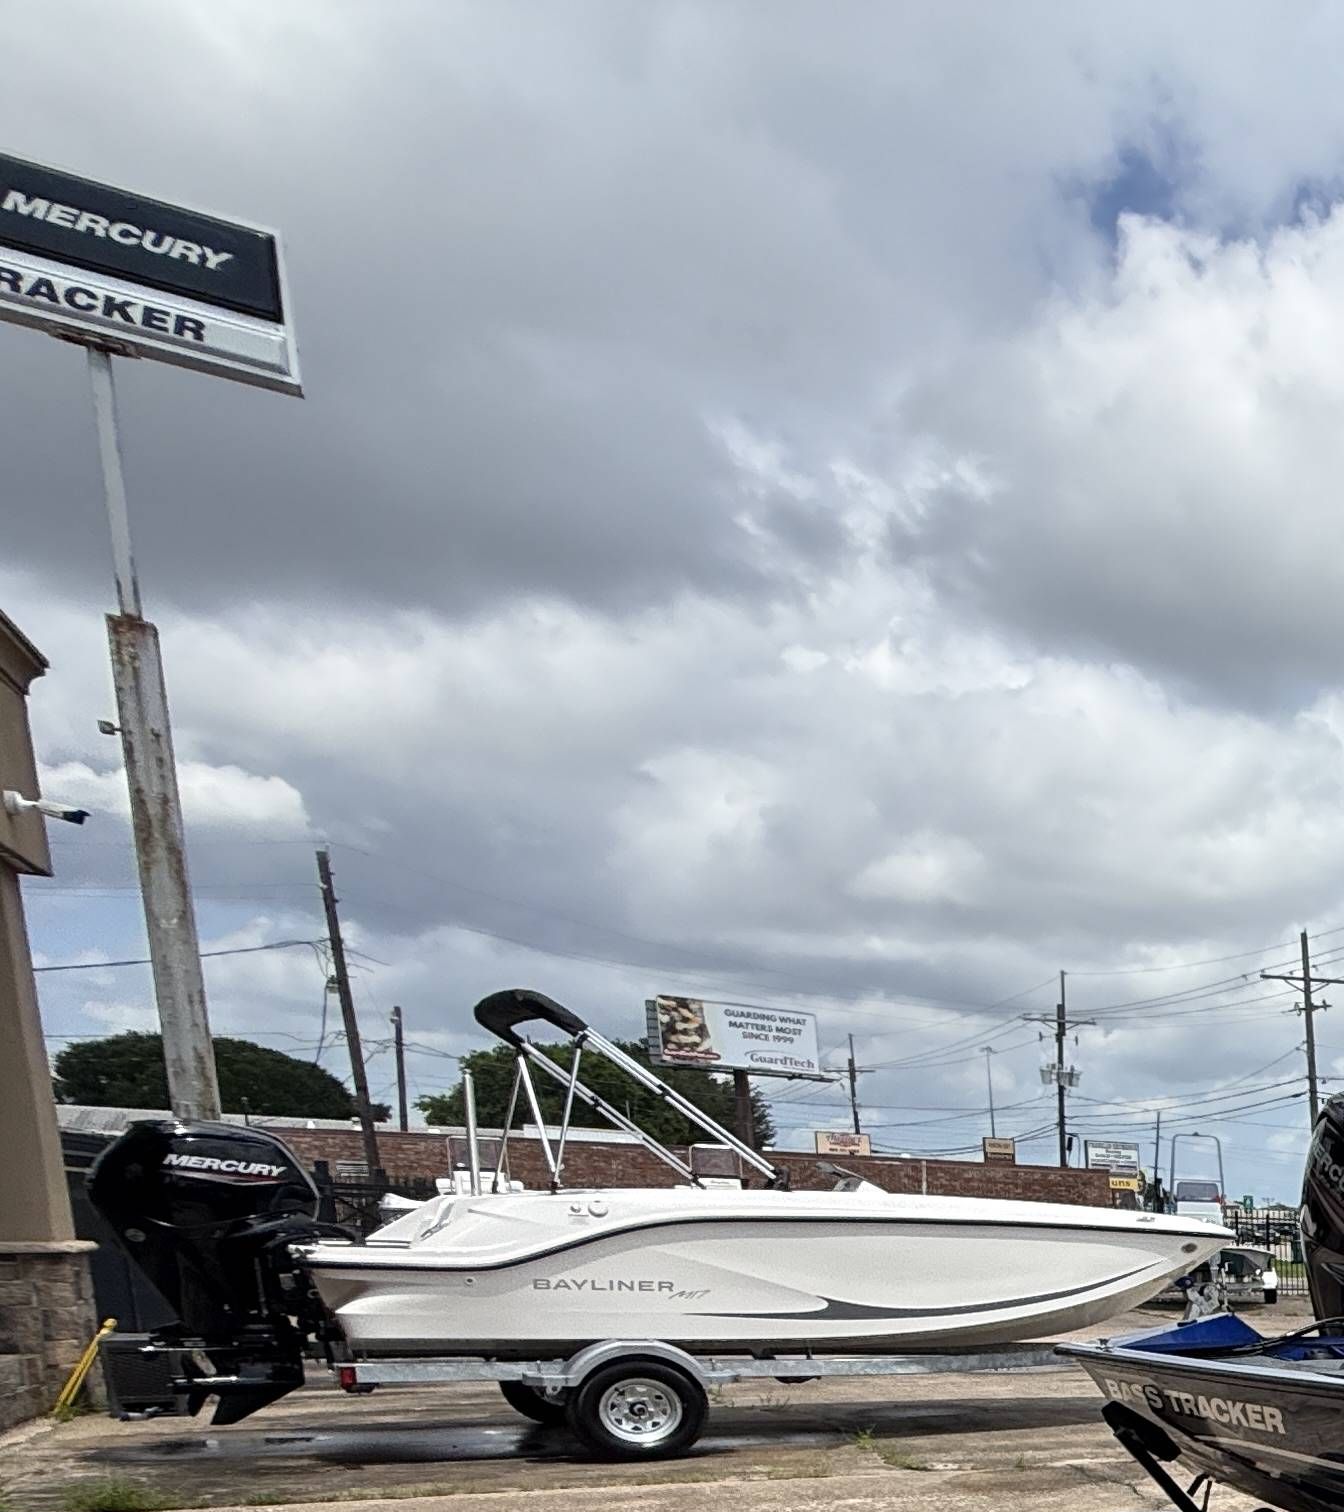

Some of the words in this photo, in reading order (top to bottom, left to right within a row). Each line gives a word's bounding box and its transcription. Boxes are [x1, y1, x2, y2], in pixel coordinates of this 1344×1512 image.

[1, 189, 234, 271] MERCURY
[724, 1008, 777, 1023] GUARDING
[779, 1015, 807, 1026] WHAT
[728, 1020, 773, 1033] MATTERS
[775, 1027, 803, 1036] MOST
[741, 1032, 770, 1042] SINCE
[772, 1035, 795, 1045] 1999
[750, 1053, 815, 1070] GuardTech
[162, 1153, 288, 1177] MERCURY
[536, 1279, 674, 1293] BAYLINER
[1105, 1378, 1164, 1410] BASS
[1163, 1389, 1286, 1435] TRACKER
